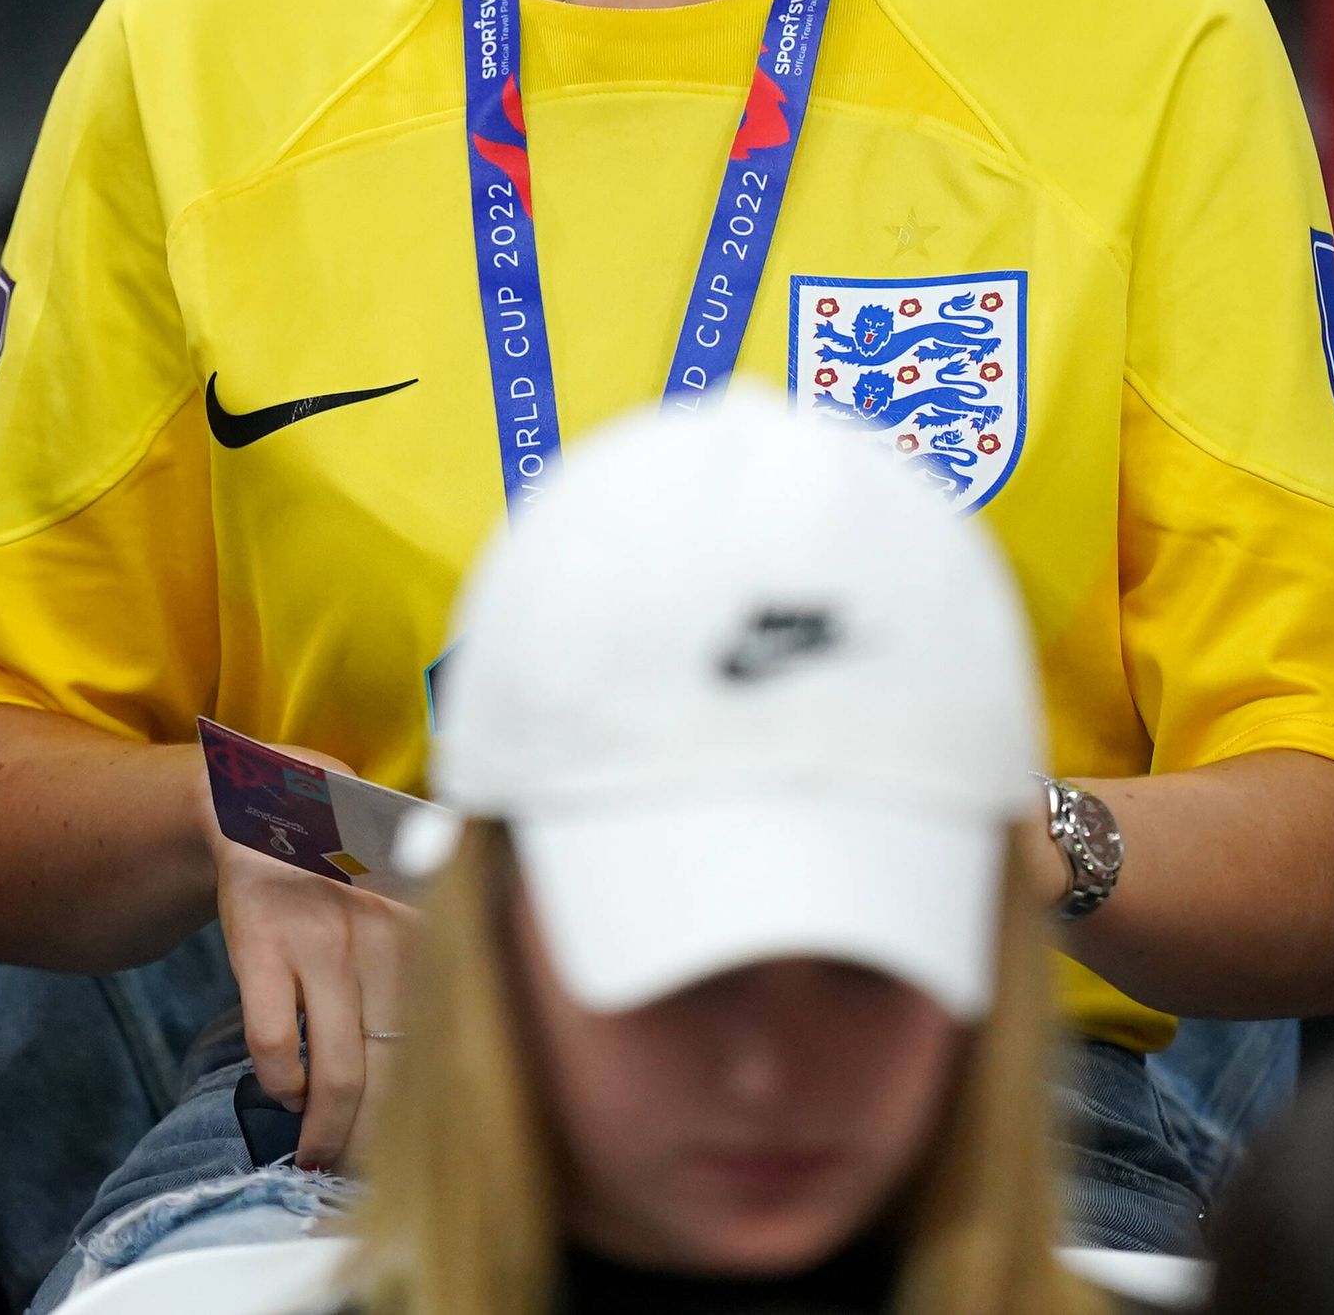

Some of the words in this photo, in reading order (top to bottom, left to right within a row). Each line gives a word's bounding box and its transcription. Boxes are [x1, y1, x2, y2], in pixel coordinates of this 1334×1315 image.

[501, 14, 509, 41] Travel
[501, 44, 510, 76] Official
[793, 43, 807, 77] Official
[801, 13, 814, 40] Travel
[488, 182, 519, 268] 2022
[696, 274, 733, 348] CUP
[722, 171, 768, 260] 2022
[498, 286, 530, 358] CUP
